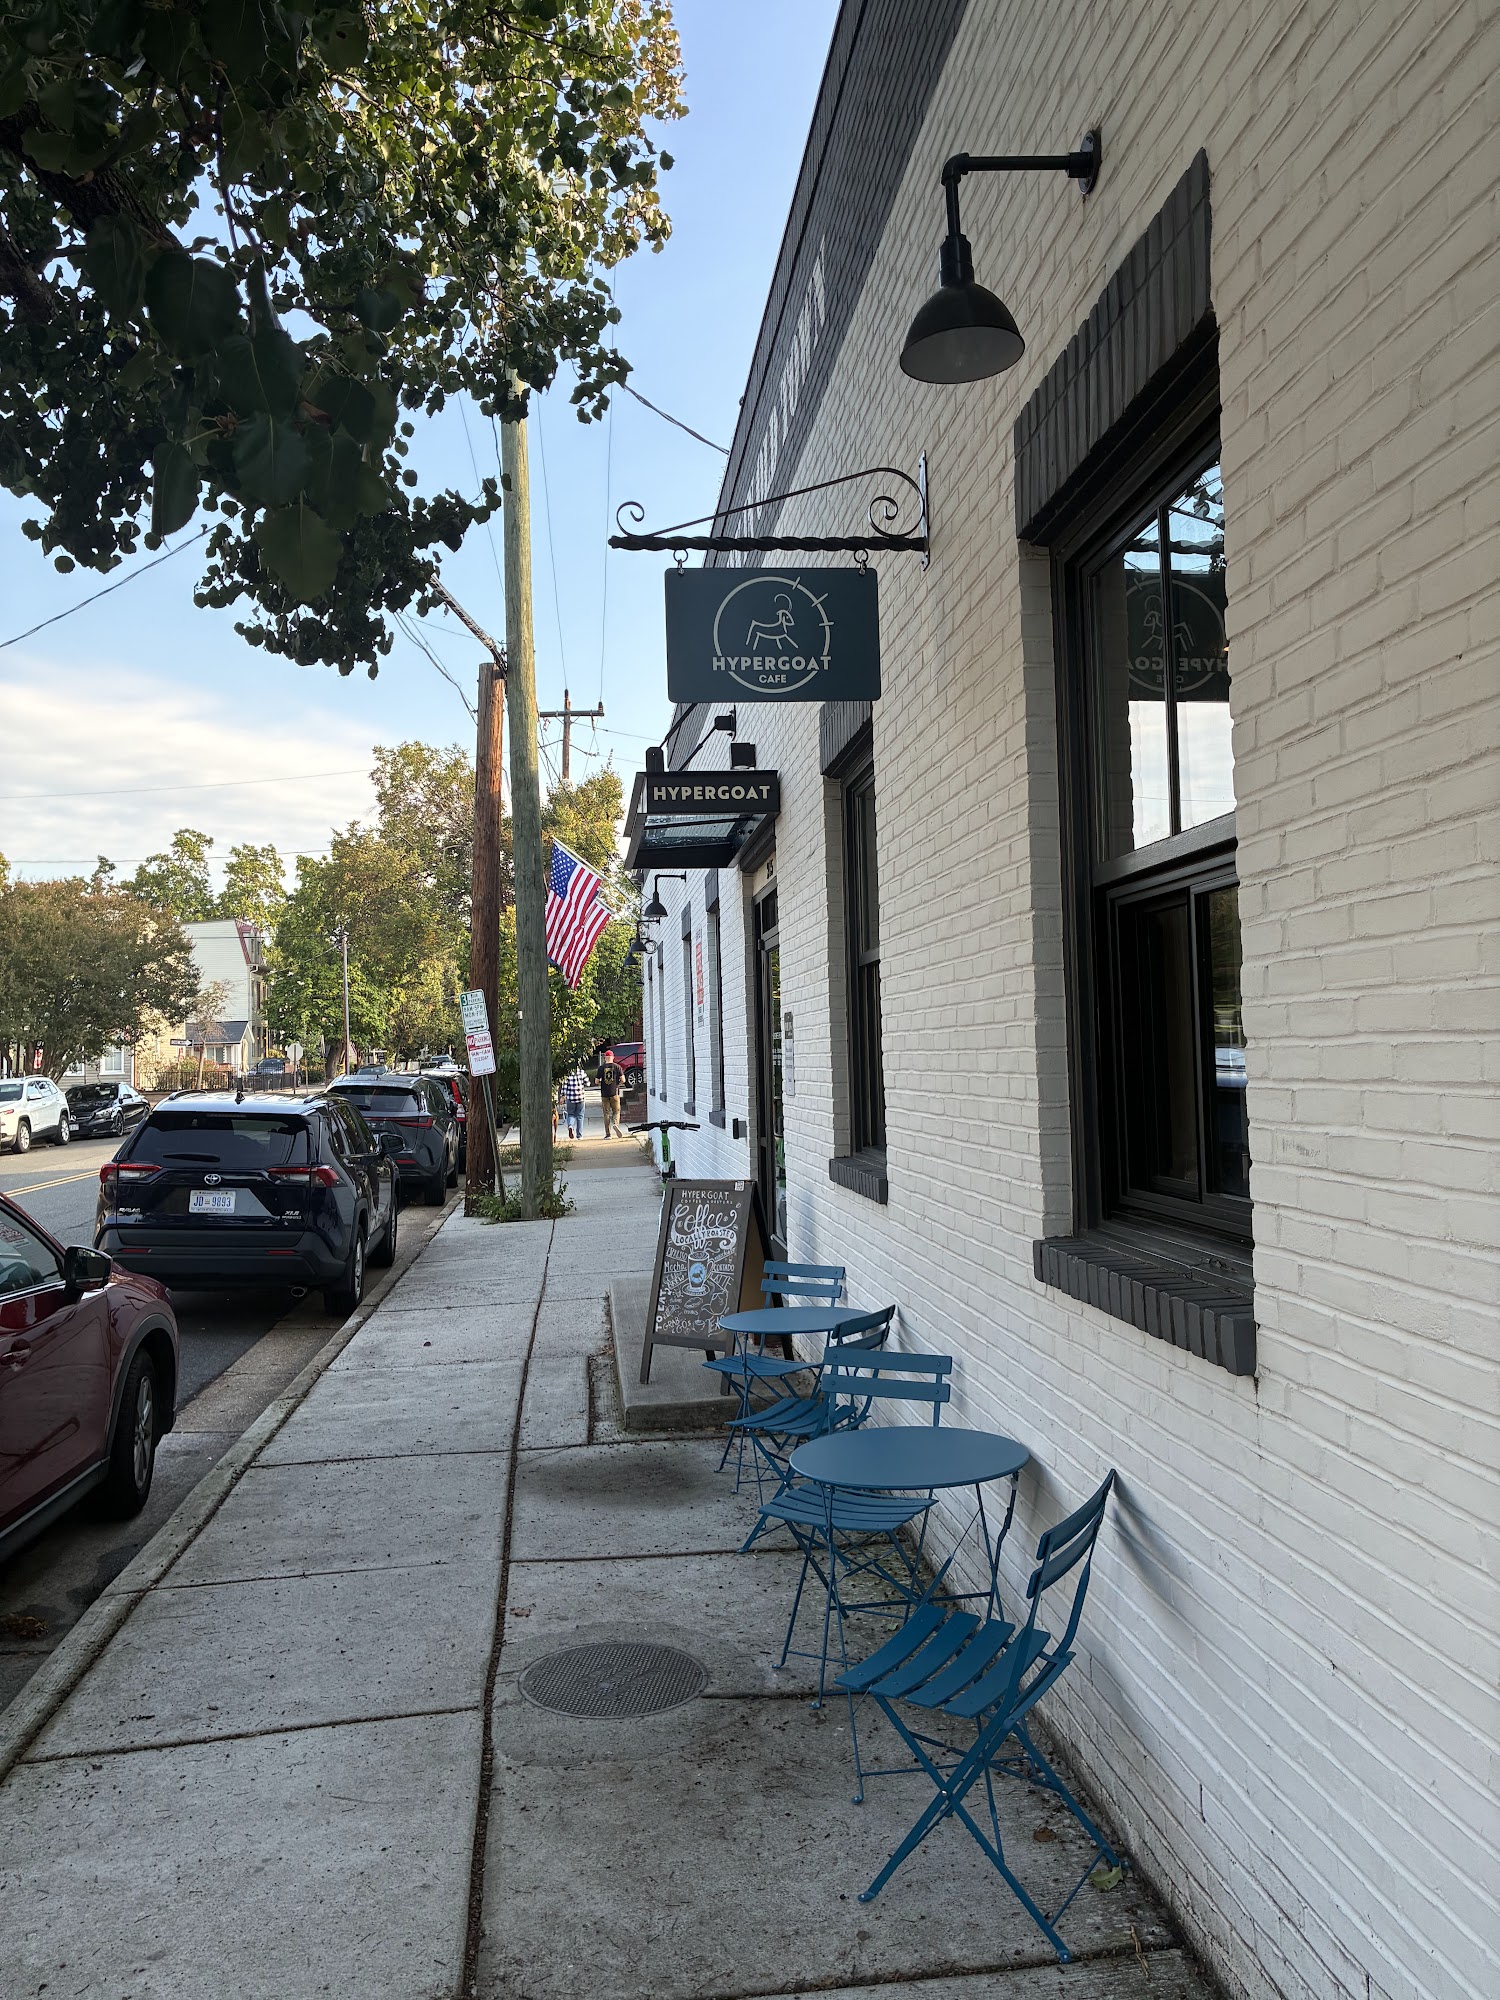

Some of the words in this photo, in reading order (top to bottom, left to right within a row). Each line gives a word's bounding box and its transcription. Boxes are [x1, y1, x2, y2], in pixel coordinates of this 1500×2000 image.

[713, 656, 831, 671] HYPERGOAT
[759, 675, 787, 684] CAFE
[653, 785, 771, 801] HYPERGOAT
[461, 994, 468, 1006] 3
[681, 1189, 730, 1200] HYPERGOAT
[675, 1227, 706, 1244] LOCALLY
[706, 1229, 735, 1239] ROASTED
